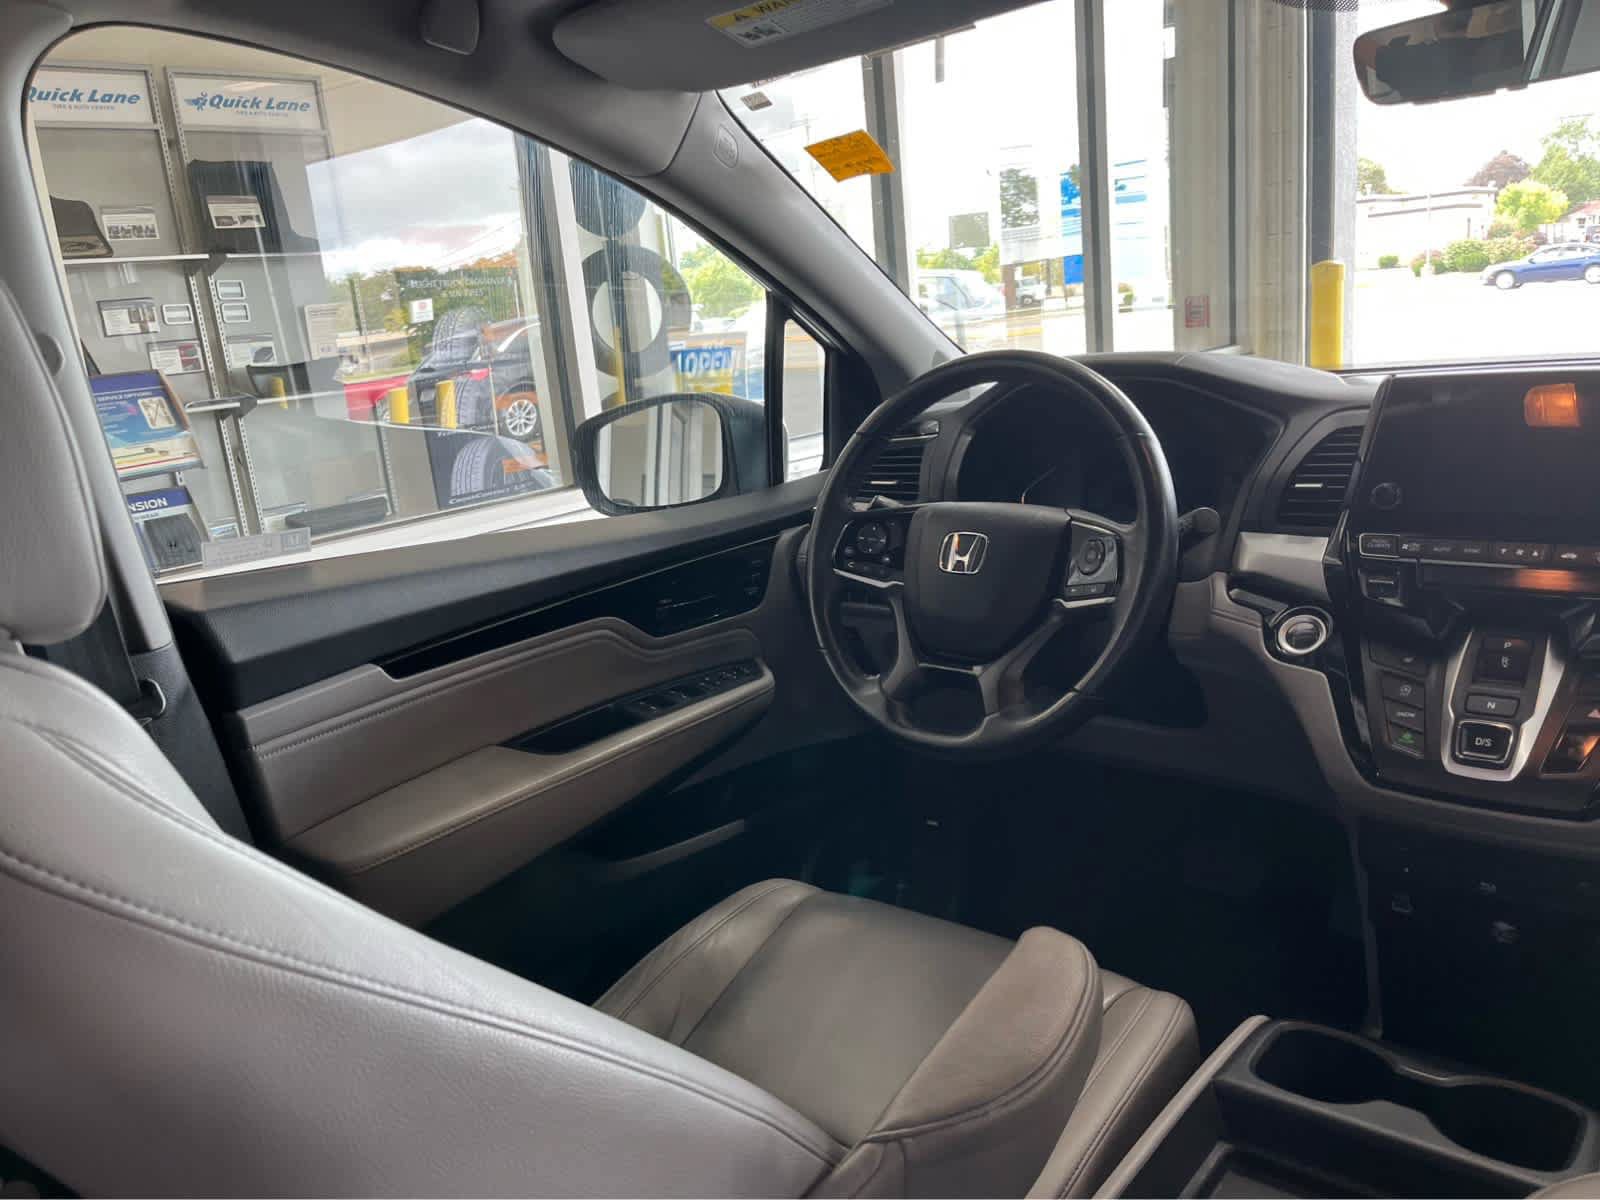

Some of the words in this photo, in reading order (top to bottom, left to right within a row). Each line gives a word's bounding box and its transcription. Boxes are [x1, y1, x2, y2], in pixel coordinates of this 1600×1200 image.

[28, 86, 84, 102] Quick
[88, 89, 141, 104] Lane
[208, 94, 262, 110] Quick
[265, 97, 311, 112] Lane
[1487, 701, 1496, 710] N
[1474, 737, 1492, 748] D/S
